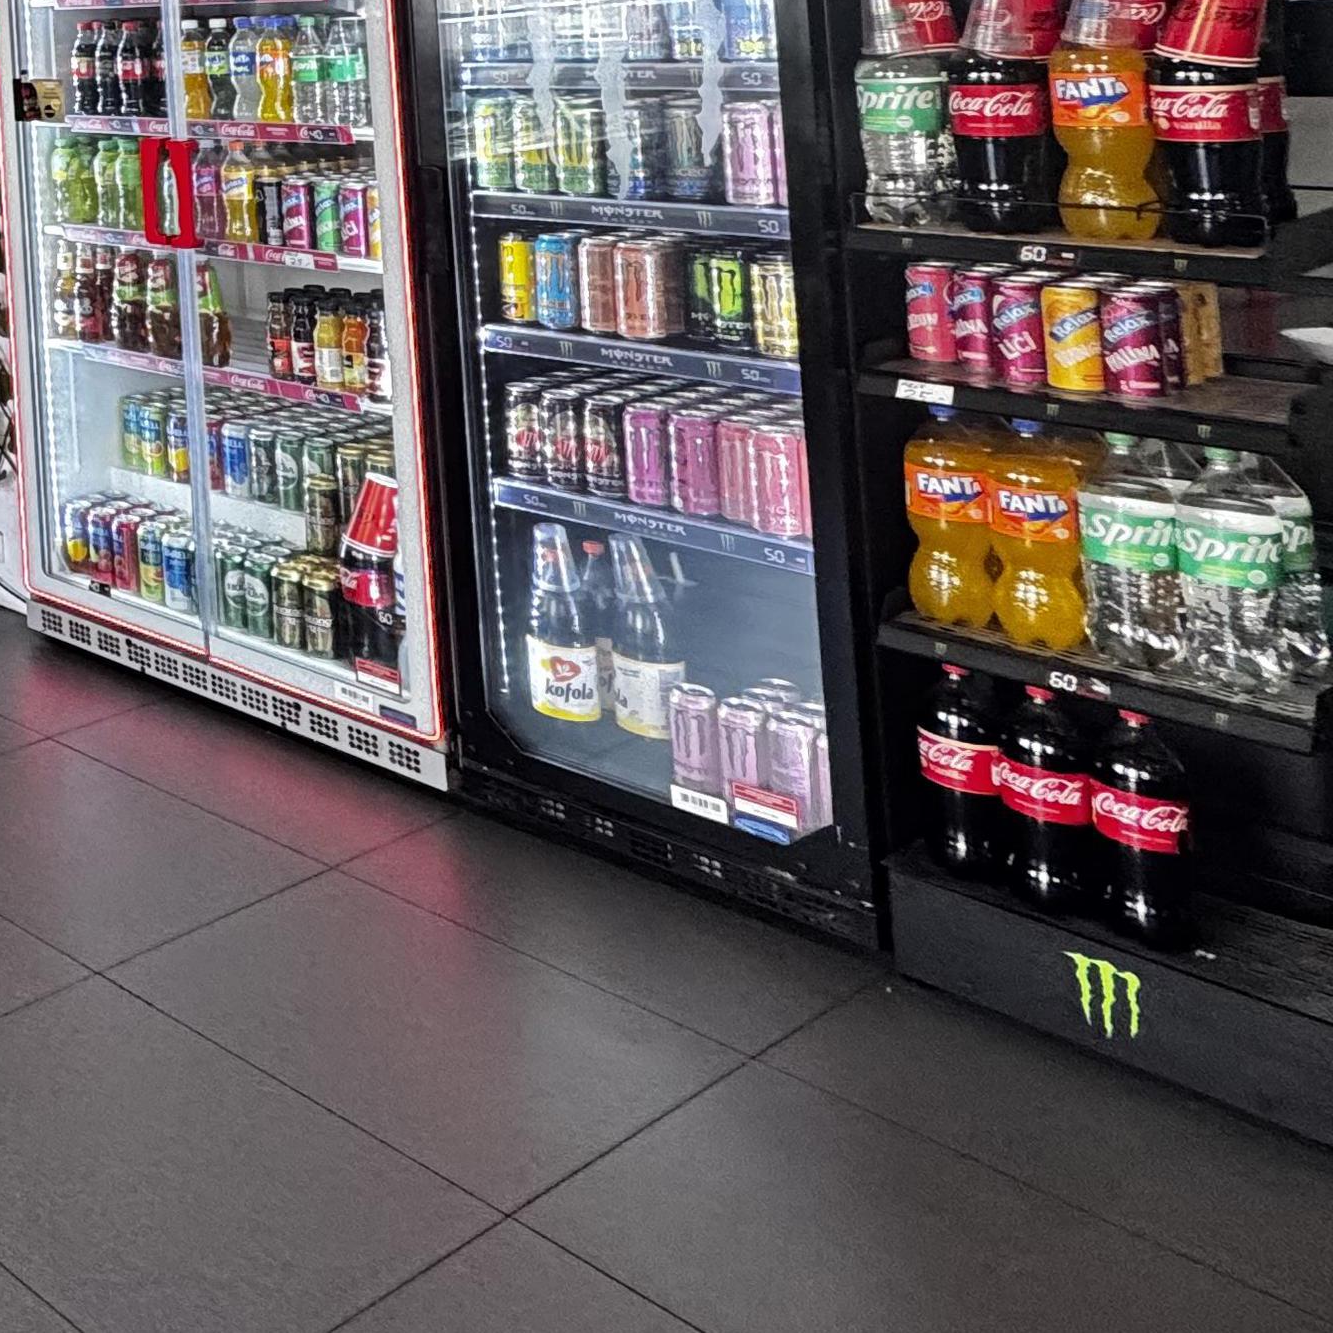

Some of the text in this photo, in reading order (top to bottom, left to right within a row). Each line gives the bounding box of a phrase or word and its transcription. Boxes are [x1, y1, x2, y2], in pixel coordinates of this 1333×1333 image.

[741, 72, 762, 86] 50
[1055, 77, 1129, 98] FANTA
[949, 91, 1035, 116] Coca-Cola
[1151, 92, 1232, 118] ca-Cola
[1173, 121, 1221, 130] vanilla
[511, 203, 525, 215] 50
[590, 204, 663, 220] MONSTER
[758, 219, 779, 233] 50
[1020, 246, 1046, 262] 60
[496, 336, 513, 349] 50
[601, 347, 673, 367] MONSTER
[741, 368, 760, 381] 50
[916, 472, 982, 495] FANTA
[523, 493, 539, 505] 50
[998, 490, 1068, 514] FANTA
[615, 511, 686, 535] MONSTER
[1087, 513, 1174, 547] Sprit
[764, 549, 785, 564] 50
[378, 611, 392, 625] 60
[545, 679, 594, 703] kofola
[1049, 671, 1077, 693] 60
[999, 761, 1083, 806] Coca-Cola
[1095, 792, 1188, 833] Coca-Cola
